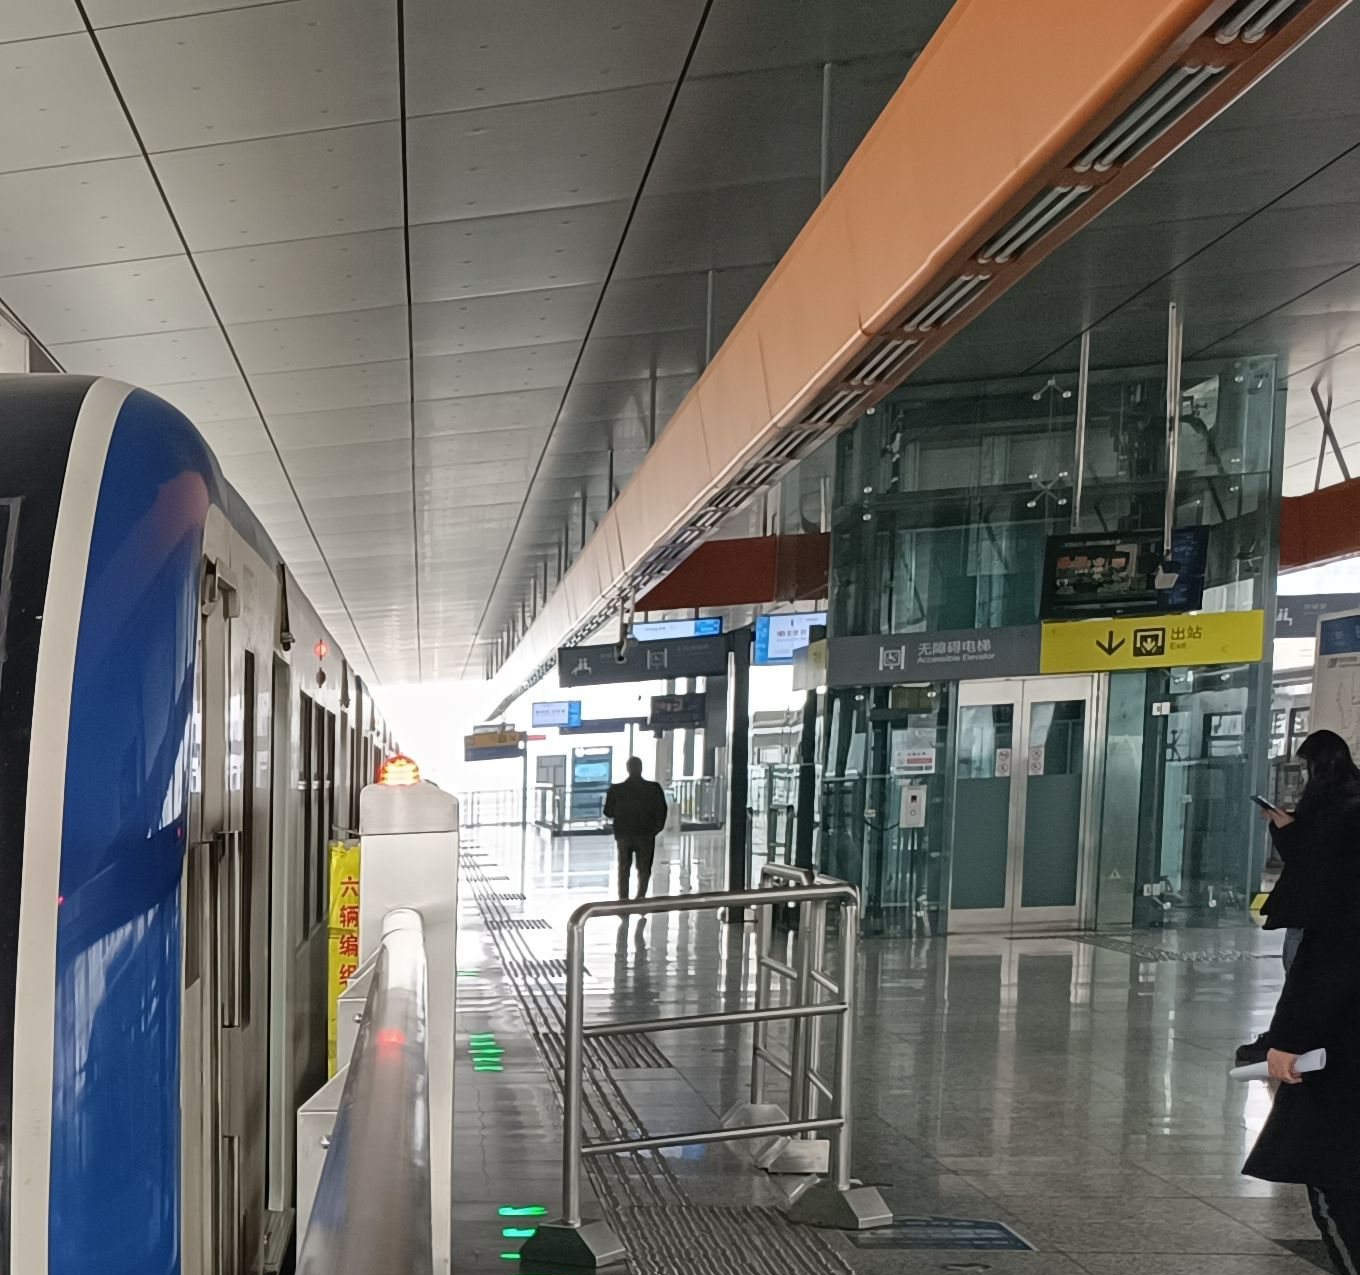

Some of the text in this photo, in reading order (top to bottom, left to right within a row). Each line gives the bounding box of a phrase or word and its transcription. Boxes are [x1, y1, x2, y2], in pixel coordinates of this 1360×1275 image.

[1170, 624, 1202, 641] 出站
[918, 638, 992, 656] 无障碍电梯
[1169, 641, 1187, 650] Exit
